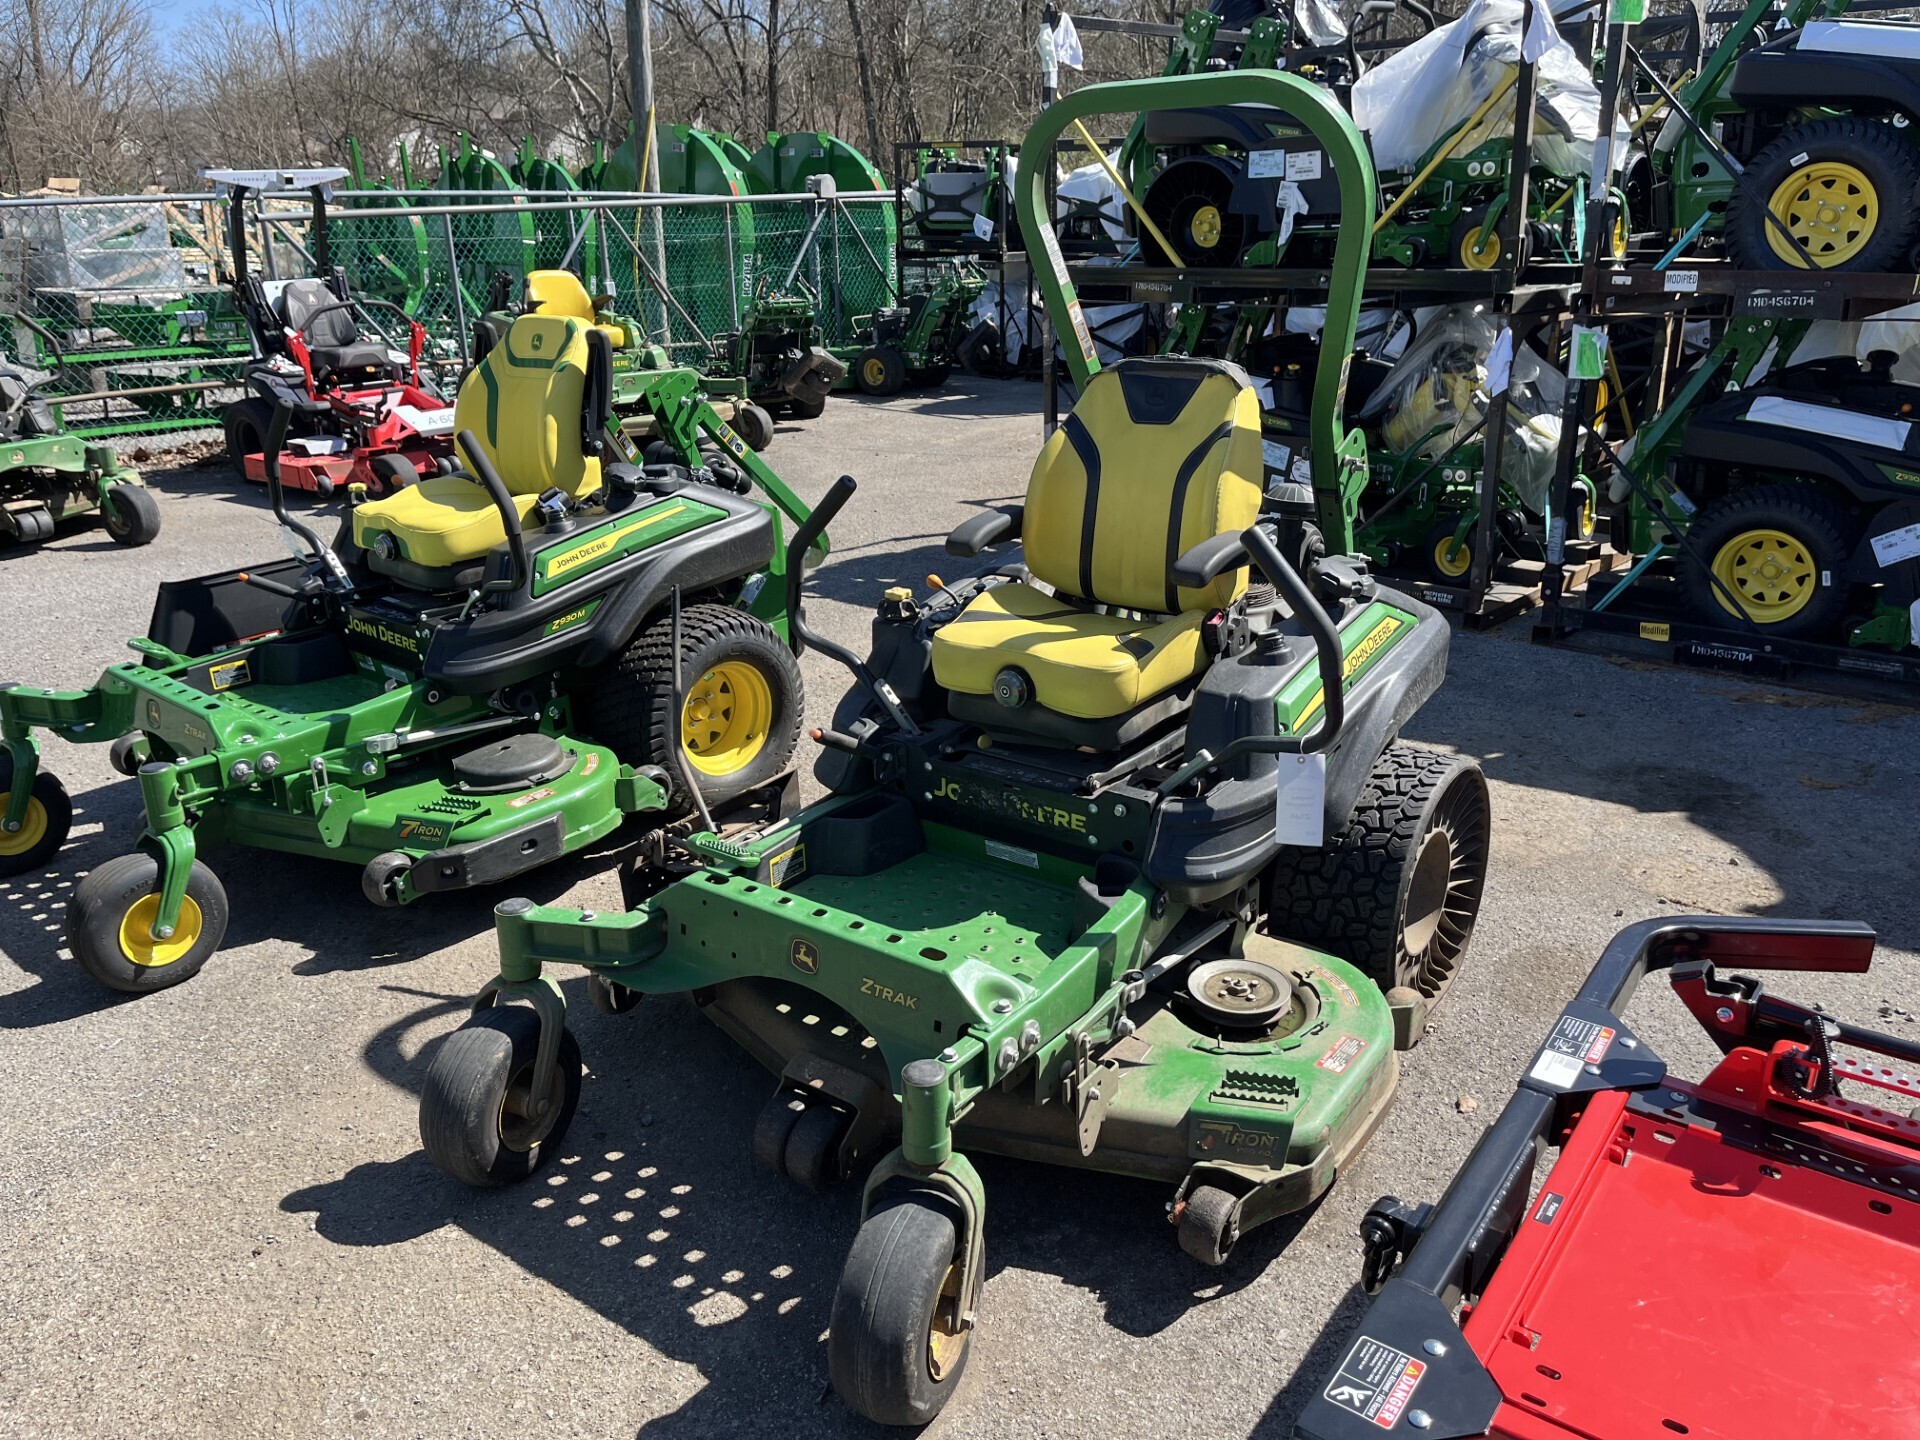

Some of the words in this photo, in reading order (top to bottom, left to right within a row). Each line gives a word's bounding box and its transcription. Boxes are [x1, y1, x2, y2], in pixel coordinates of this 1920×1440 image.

[1666, 273, 1698, 285] MODIFIED
[613, 359, 629, 368] EERE
[556, 553, 579, 569] JOHN
[579, 541, 608, 558] DEERE
[552, 609, 586, 630] Z930M
[1640, 625, 1669, 636] Modified
[347, 614, 377, 639] JOHN
[378, 625, 418, 653] DEERE
[1348, 645, 1368, 673] JOHN
[1368, 622, 1393, 651] DEERE
[183, 722, 207, 740] ZTRAK
[860, 977, 918, 1010] ZTRAK
[1379, 1373, 1415, 1422] DANGER
